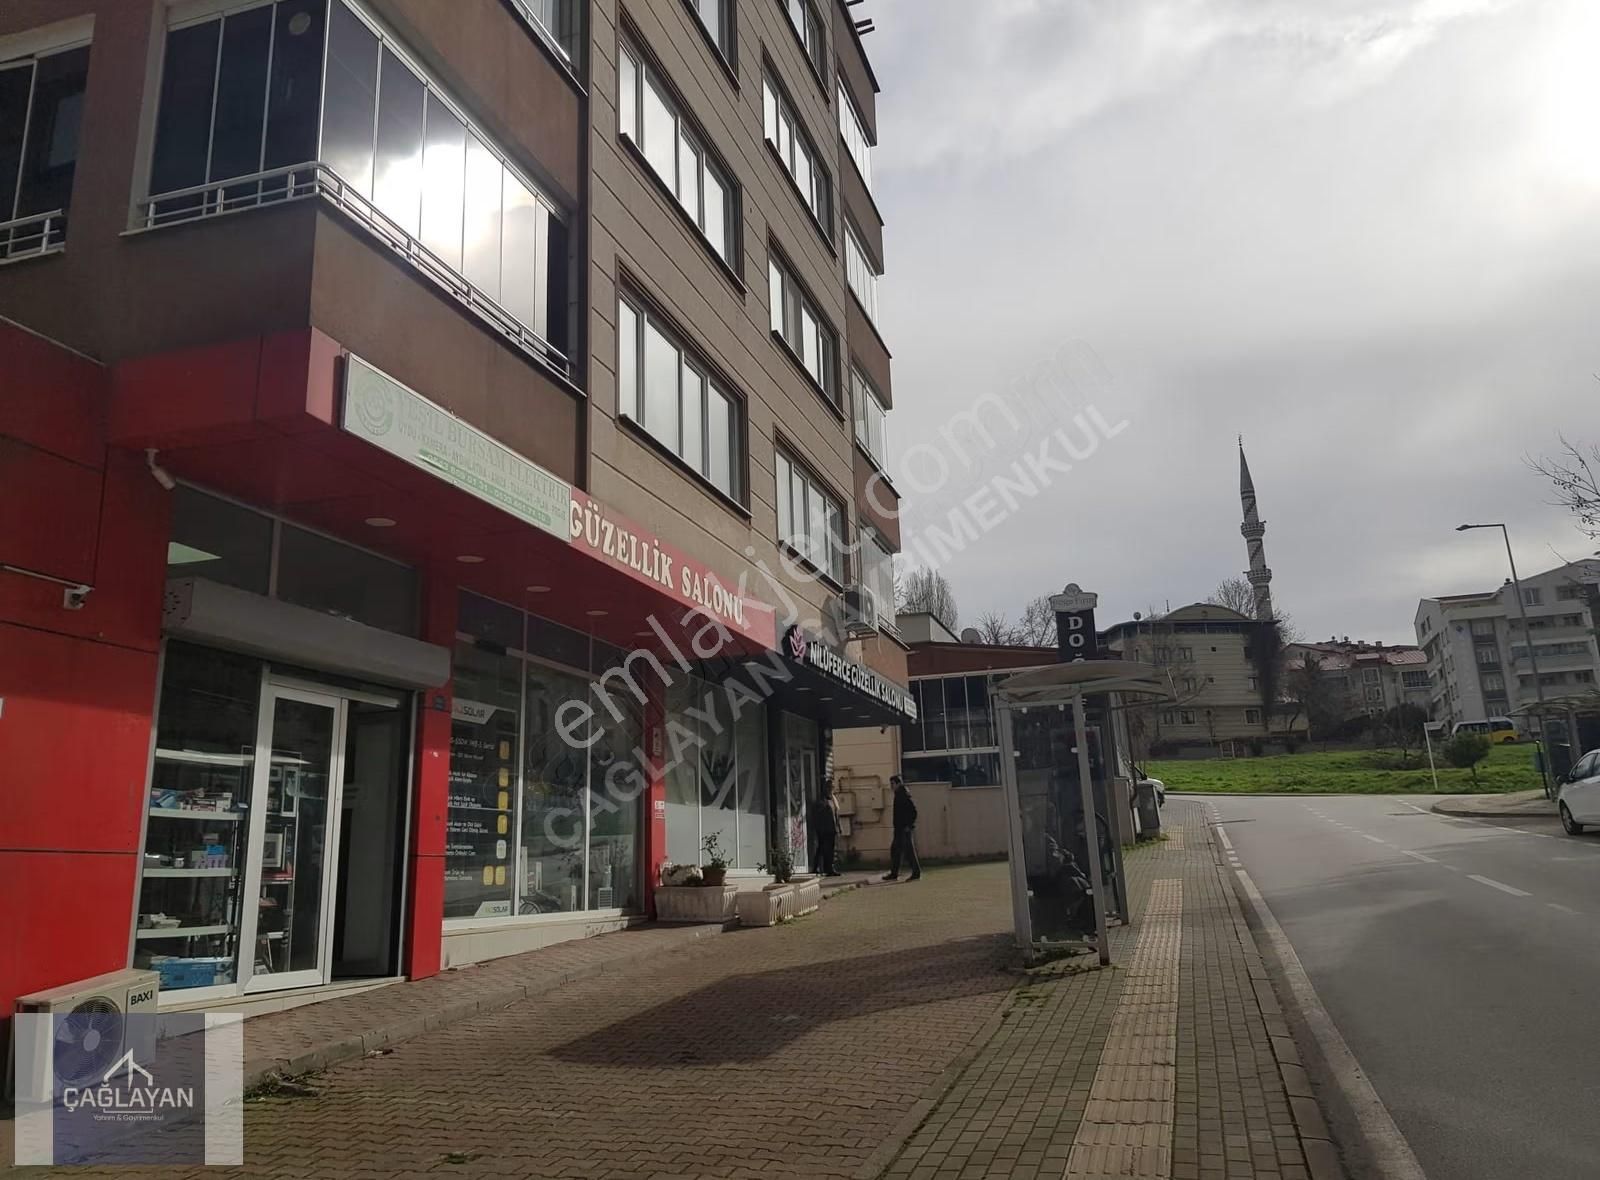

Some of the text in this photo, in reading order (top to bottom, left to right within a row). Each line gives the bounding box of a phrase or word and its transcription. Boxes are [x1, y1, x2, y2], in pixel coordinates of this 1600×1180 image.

[570, 500, 743, 625] GÜZELLİK SALONU
[130, 989, 153, 1006] BAXI
